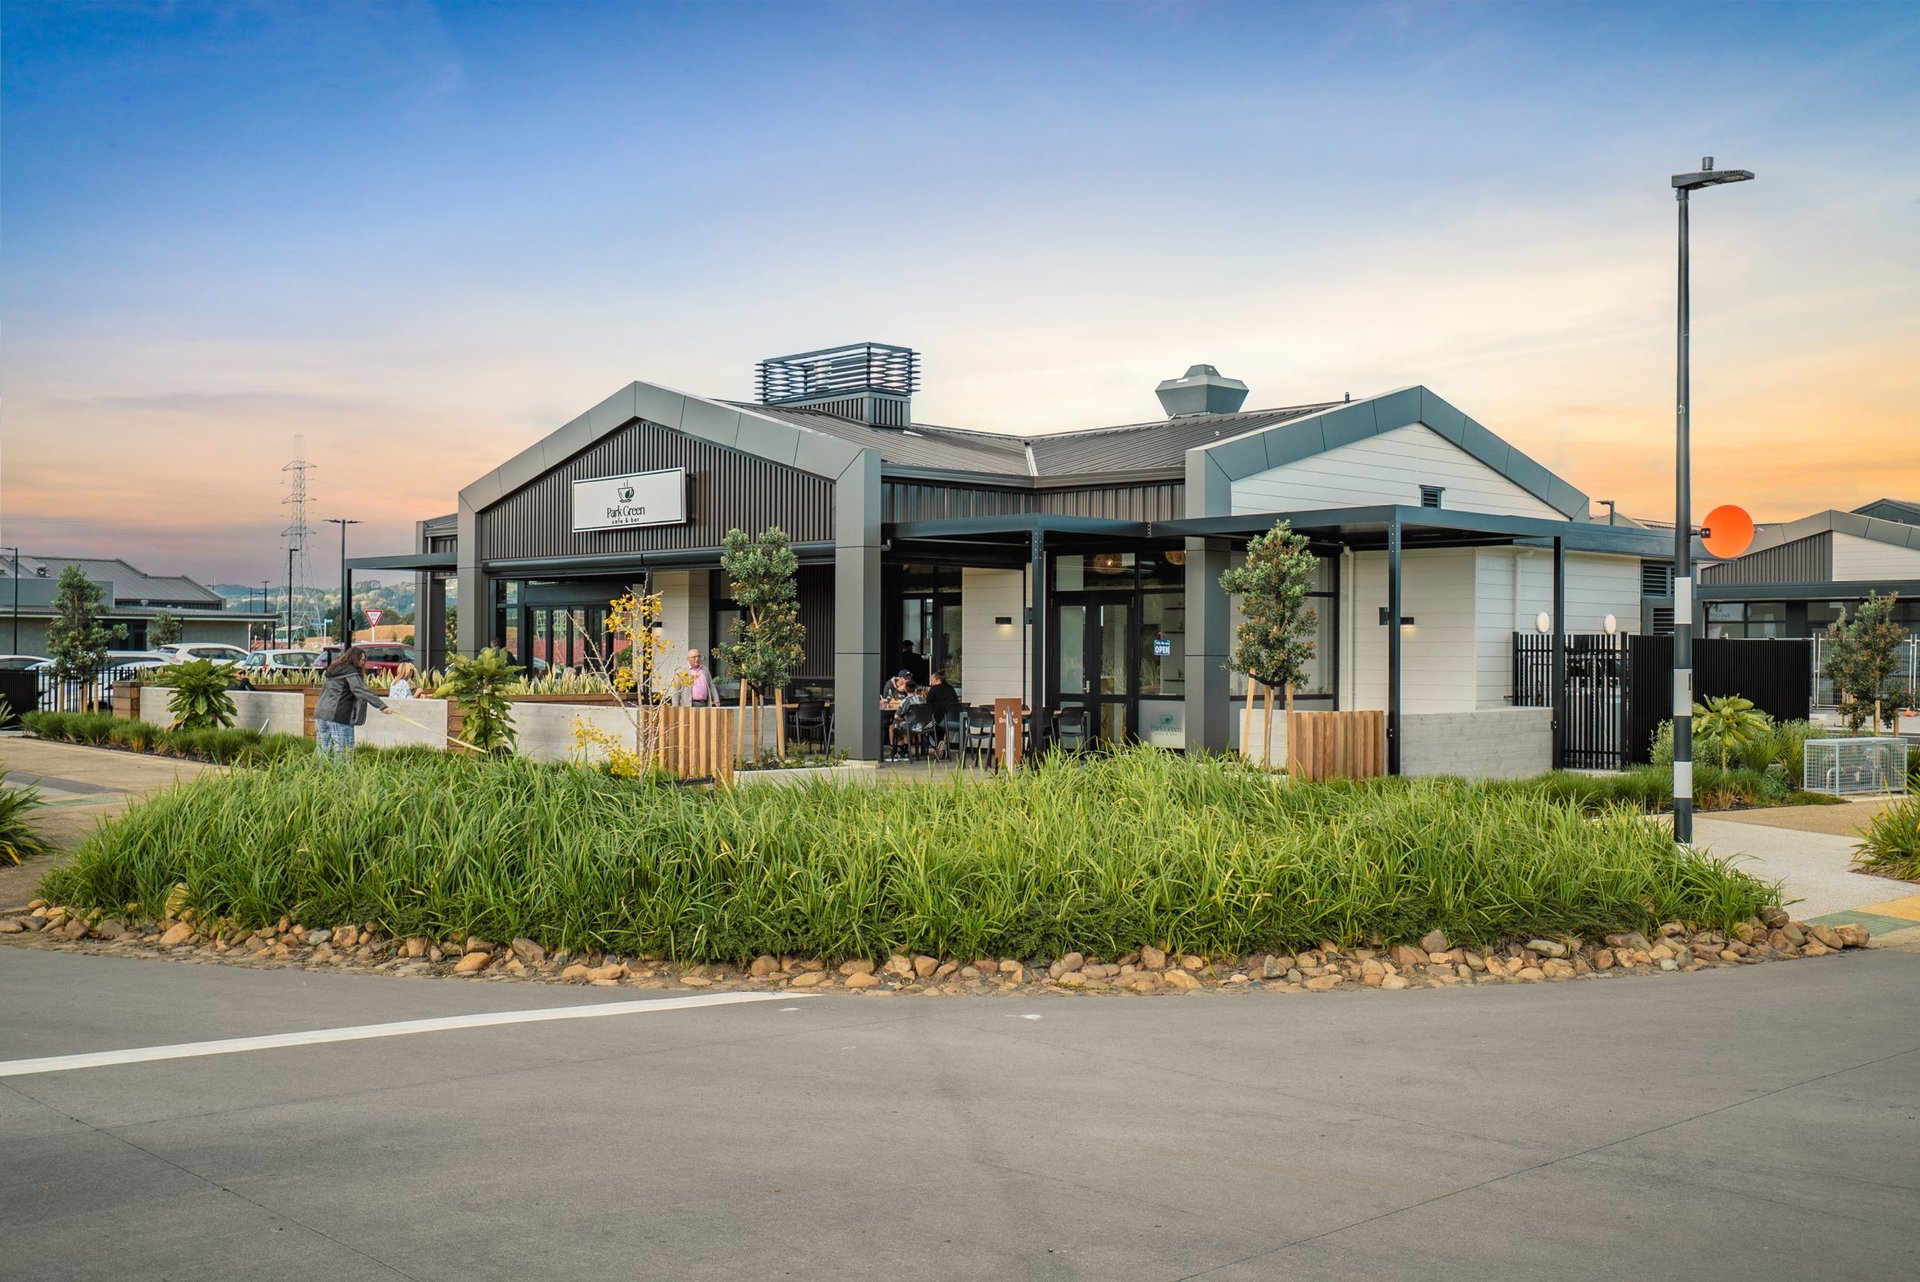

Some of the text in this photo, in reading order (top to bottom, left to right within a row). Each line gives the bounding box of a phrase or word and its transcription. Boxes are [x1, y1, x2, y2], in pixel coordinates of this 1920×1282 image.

[606, 505, 646, 518] Park Green
[1155, 645, 1170, 654] OPEN
